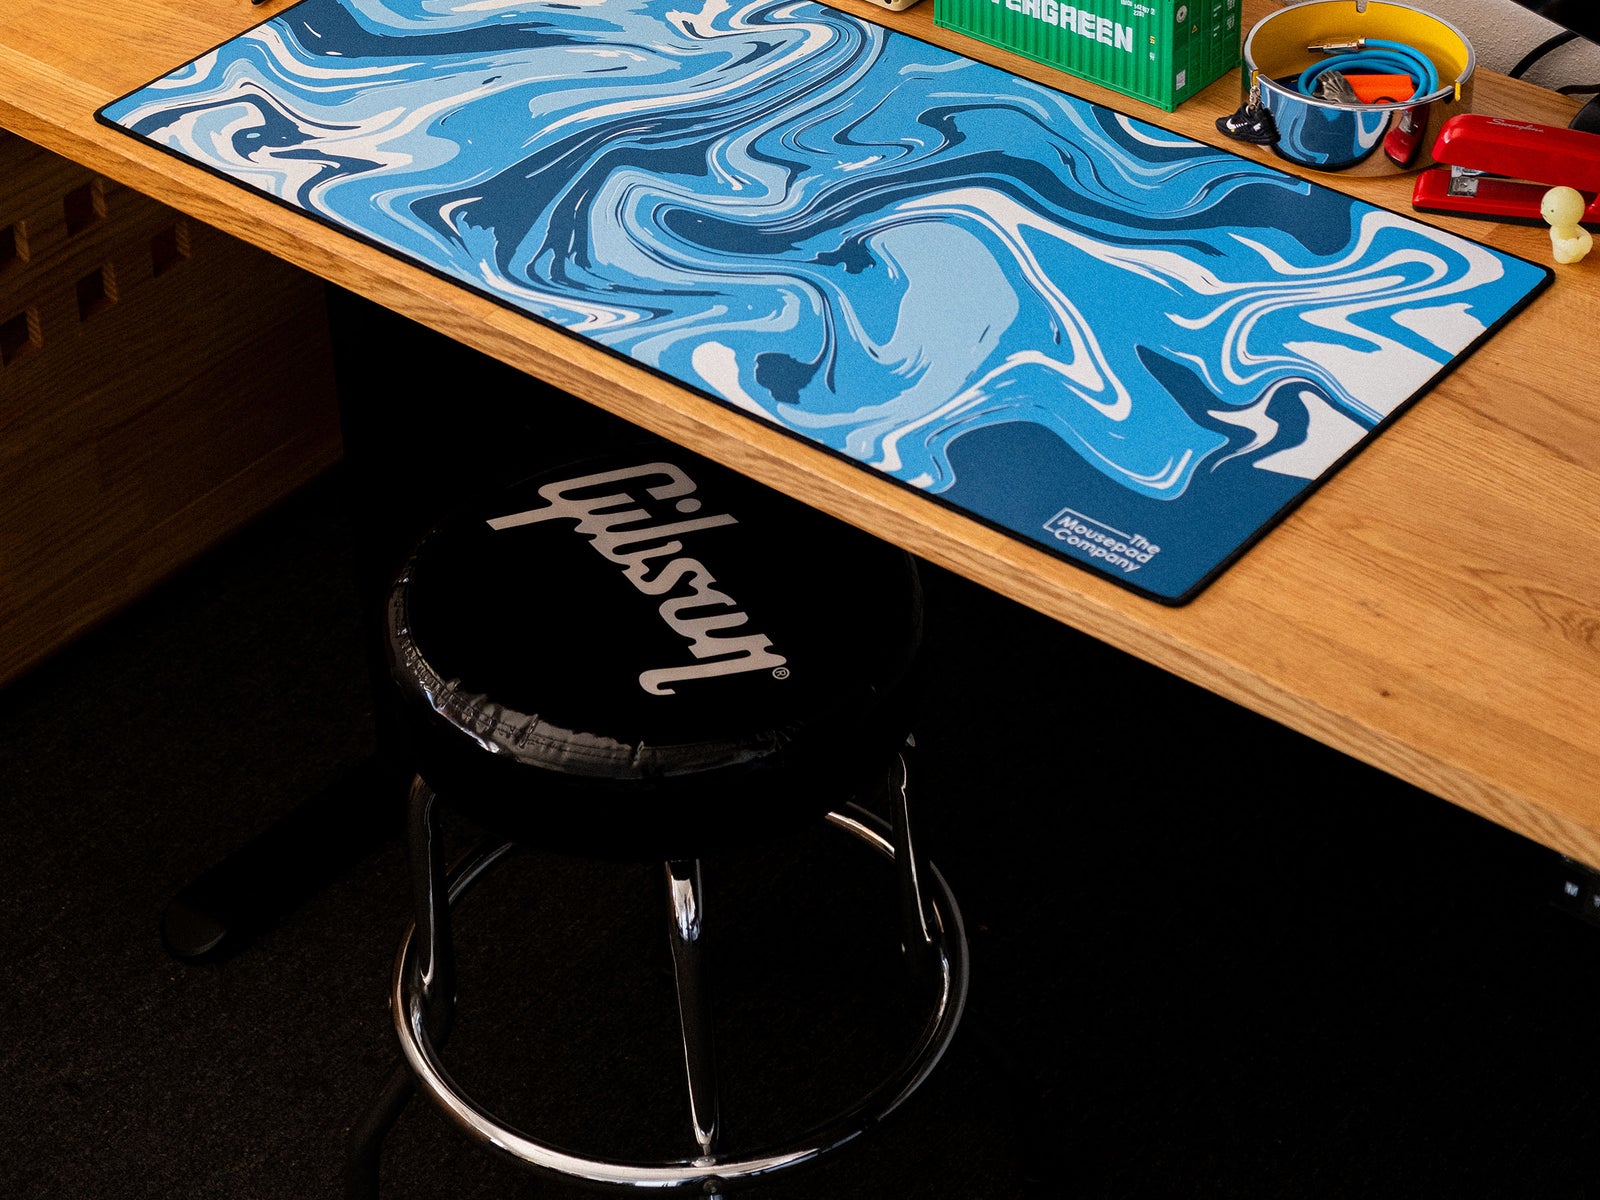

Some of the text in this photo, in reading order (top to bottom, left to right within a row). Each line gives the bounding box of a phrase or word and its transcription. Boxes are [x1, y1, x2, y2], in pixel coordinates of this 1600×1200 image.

[1054, 528, 1141, 573] Company
[1057, 516, 1153, 564] Mousepad
[1130, 533, 1161, 555] The
[486, 462, 788, 696] Gibson
